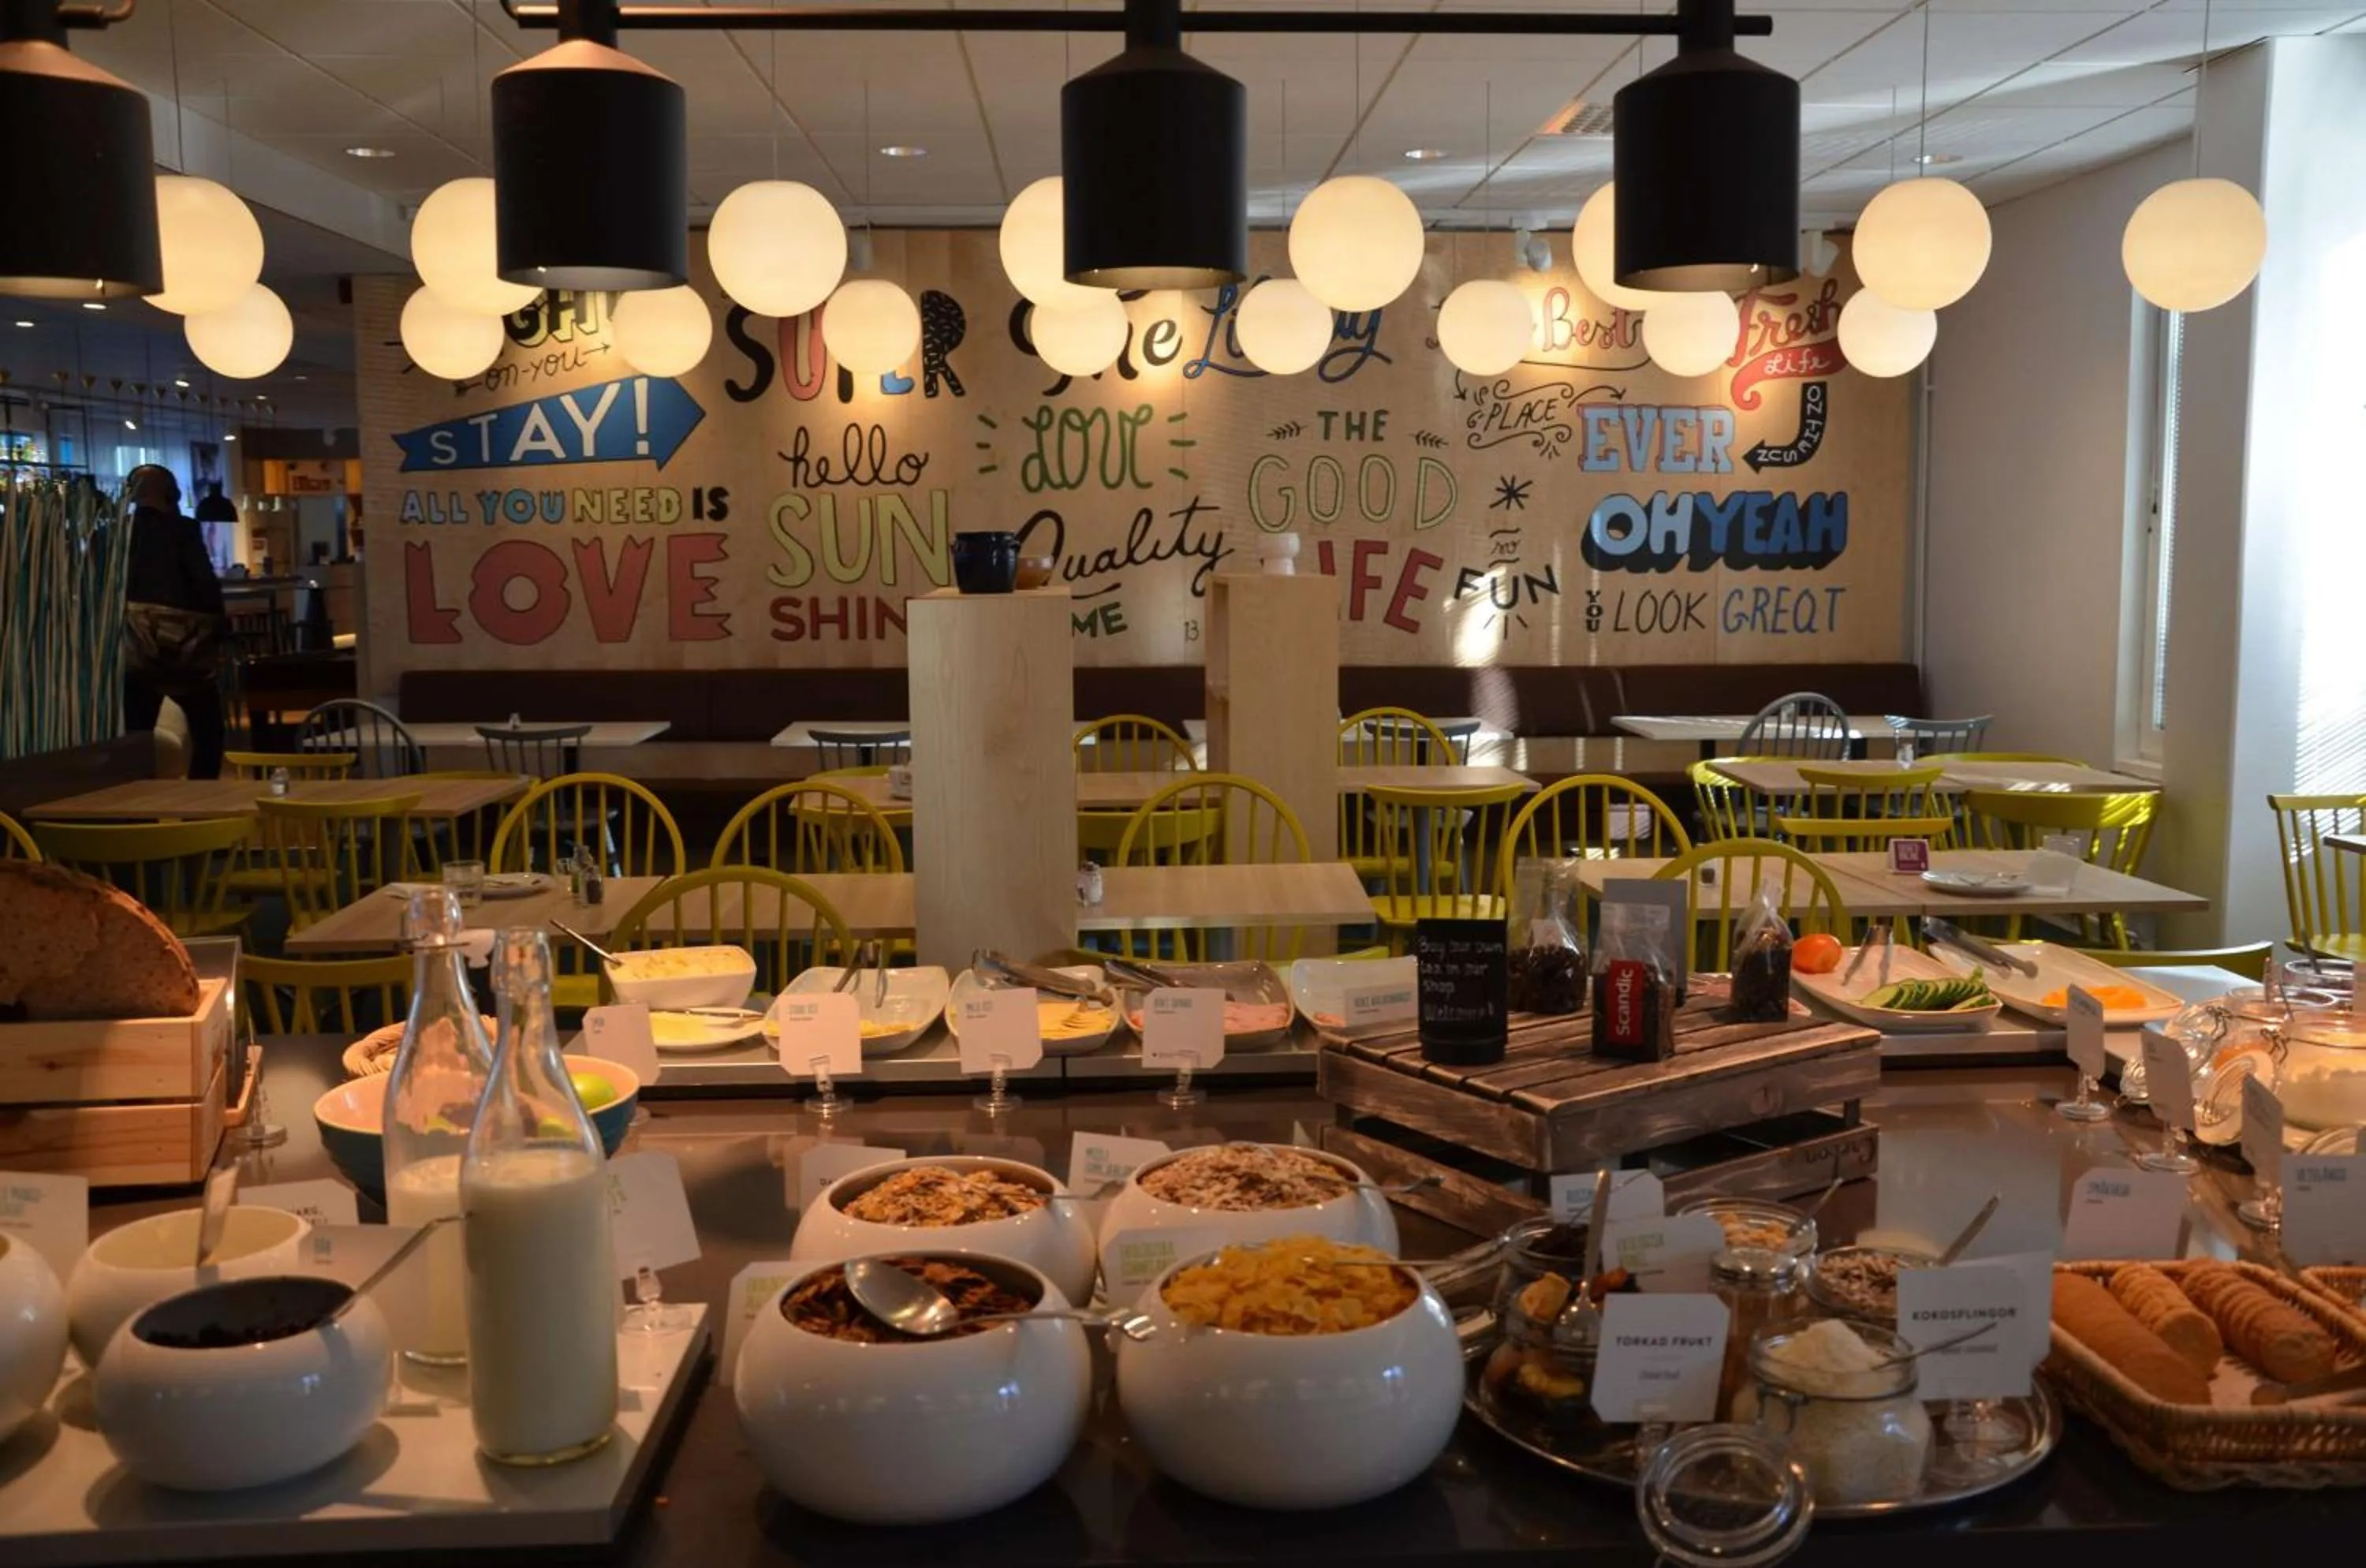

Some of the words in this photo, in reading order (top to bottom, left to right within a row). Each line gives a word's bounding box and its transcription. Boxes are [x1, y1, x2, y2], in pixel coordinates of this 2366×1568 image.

[725, 289, 966, 402] SUR
[1540, 286, 1643, 352] Best
[429, 377, 650, 465] STAY!
[1317, 409, 1389, 442] THE
[1483, 398, 1559, 433] PLACE
[1577, 402, 1734, 474] EVER
[778, 422, 930, 488] hello
[400, 488, 468, 524] ALL
[476, 487, 565, 525] YOU
[573, 486, 682, 525] NEED
[692, 487, 730, 522] IS
[1248, 454, 1457, 533] GOOD
[767, 488, 951, 588] SUN
[404, 533, 733, 646] LOVE
[770, 595, 908, 641] SHIN
[1454, 565, 1560, 610] FUN
[1585, 590, 1603, 632] YOU
[1613, 589, 1707, 633] LOOK
[1616, 969, 1634, 1036] Scandic
[1615, 1335, 1668, 1346] TORKAD
[1670, 1336, 1713, 1346] FRUKT
[1913, 1307, 2017, 1321] KOKOSFLINGOR
